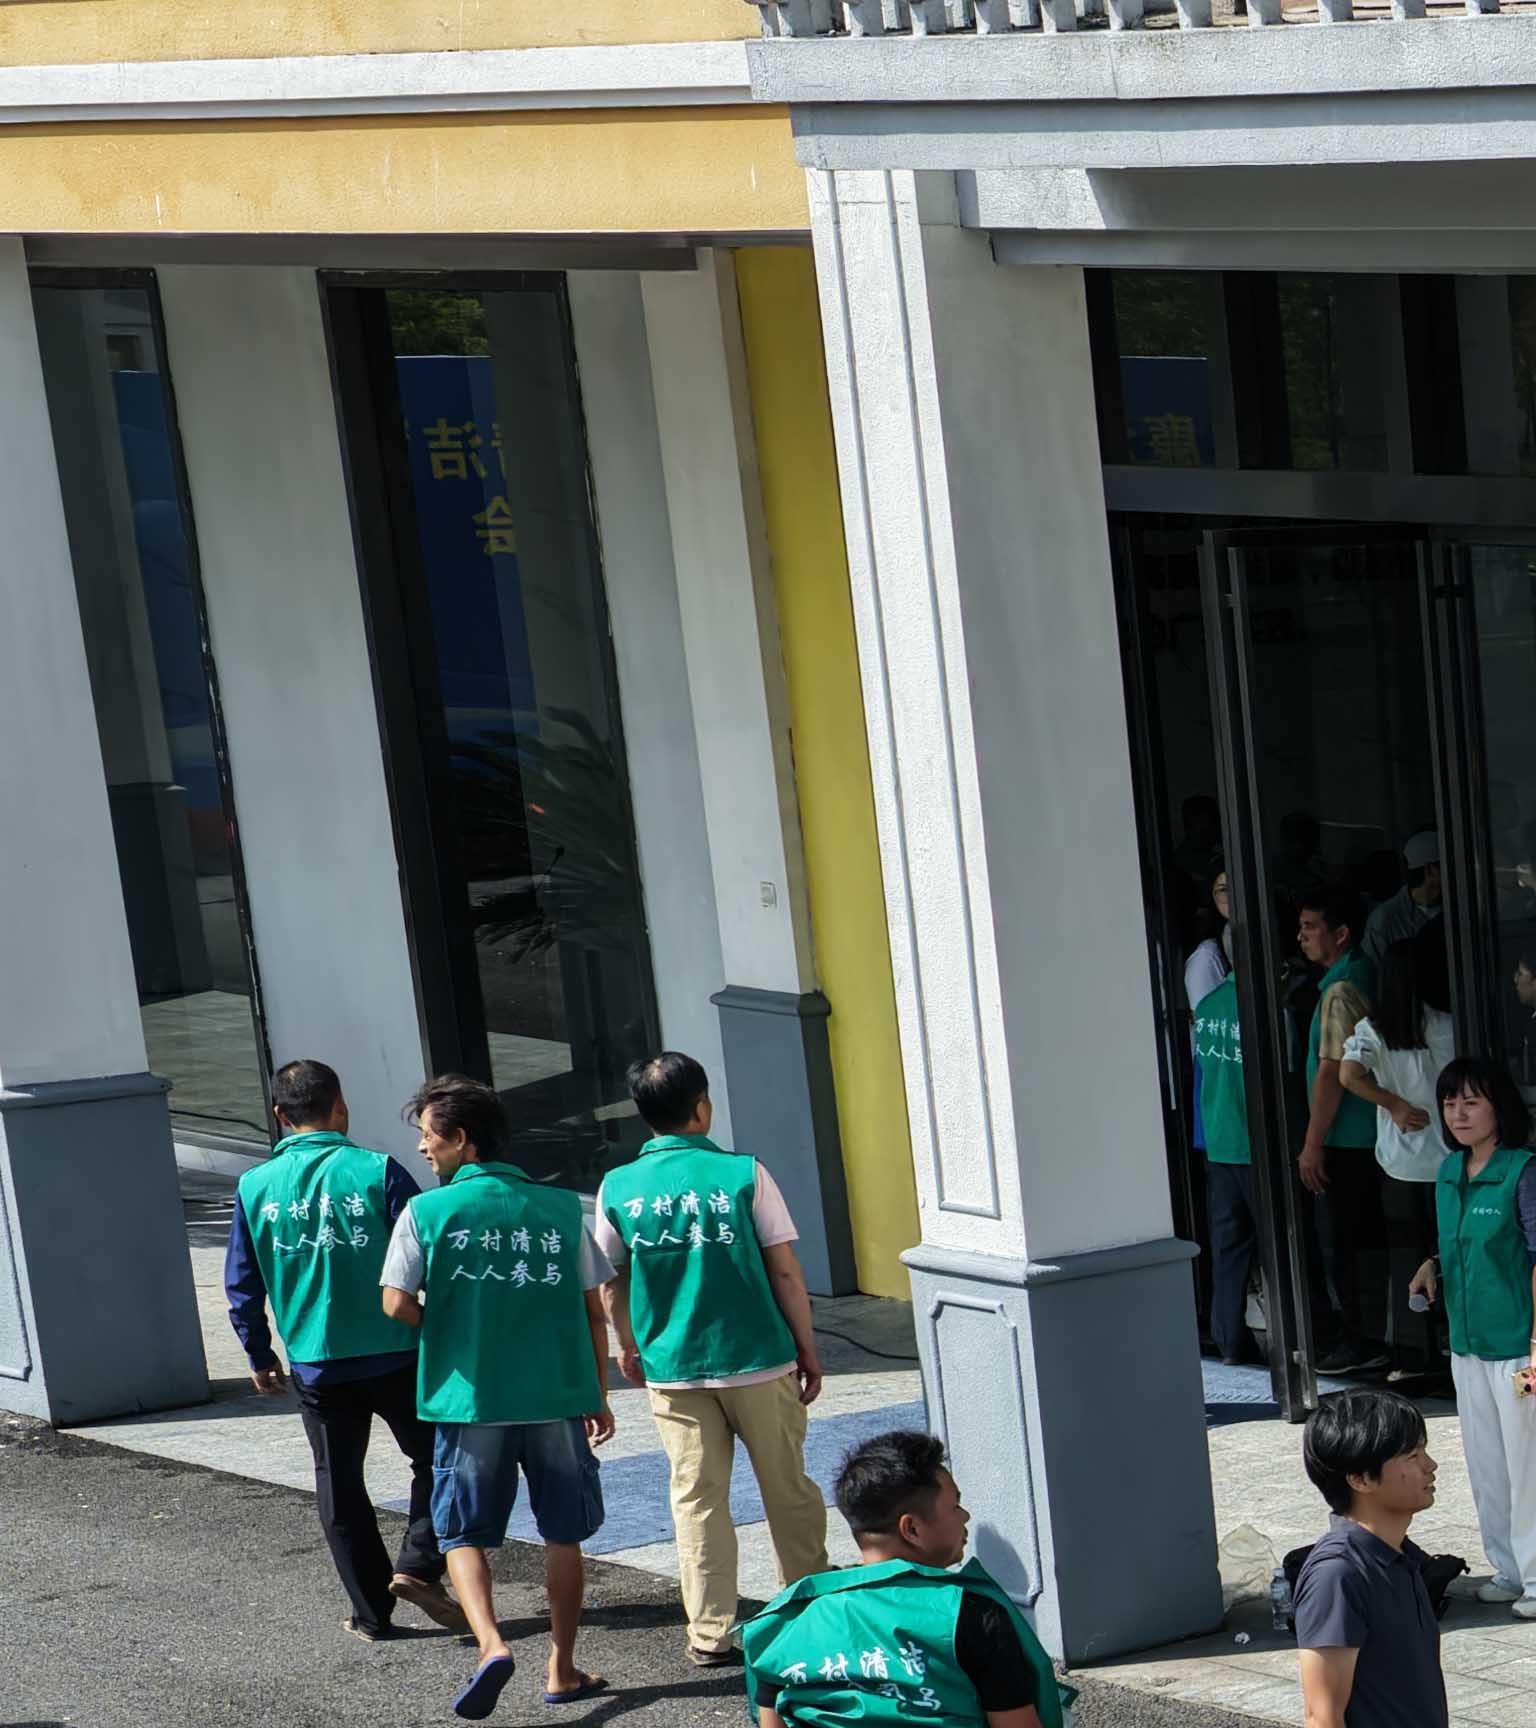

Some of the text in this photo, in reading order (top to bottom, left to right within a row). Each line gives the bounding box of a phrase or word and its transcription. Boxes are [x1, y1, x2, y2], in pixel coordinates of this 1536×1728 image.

[261, 1192, 365, 1223] 万村清洁
[624, 1189, 731, 1218] 万村清洁
[273, 1223, 369, 1253] 人人参与
[447, 1227, 562, 1254] 万村清洁
[630, 1221, 735, 1248] 人人参与
[450, 1260, 563, 1288] 人人参与
